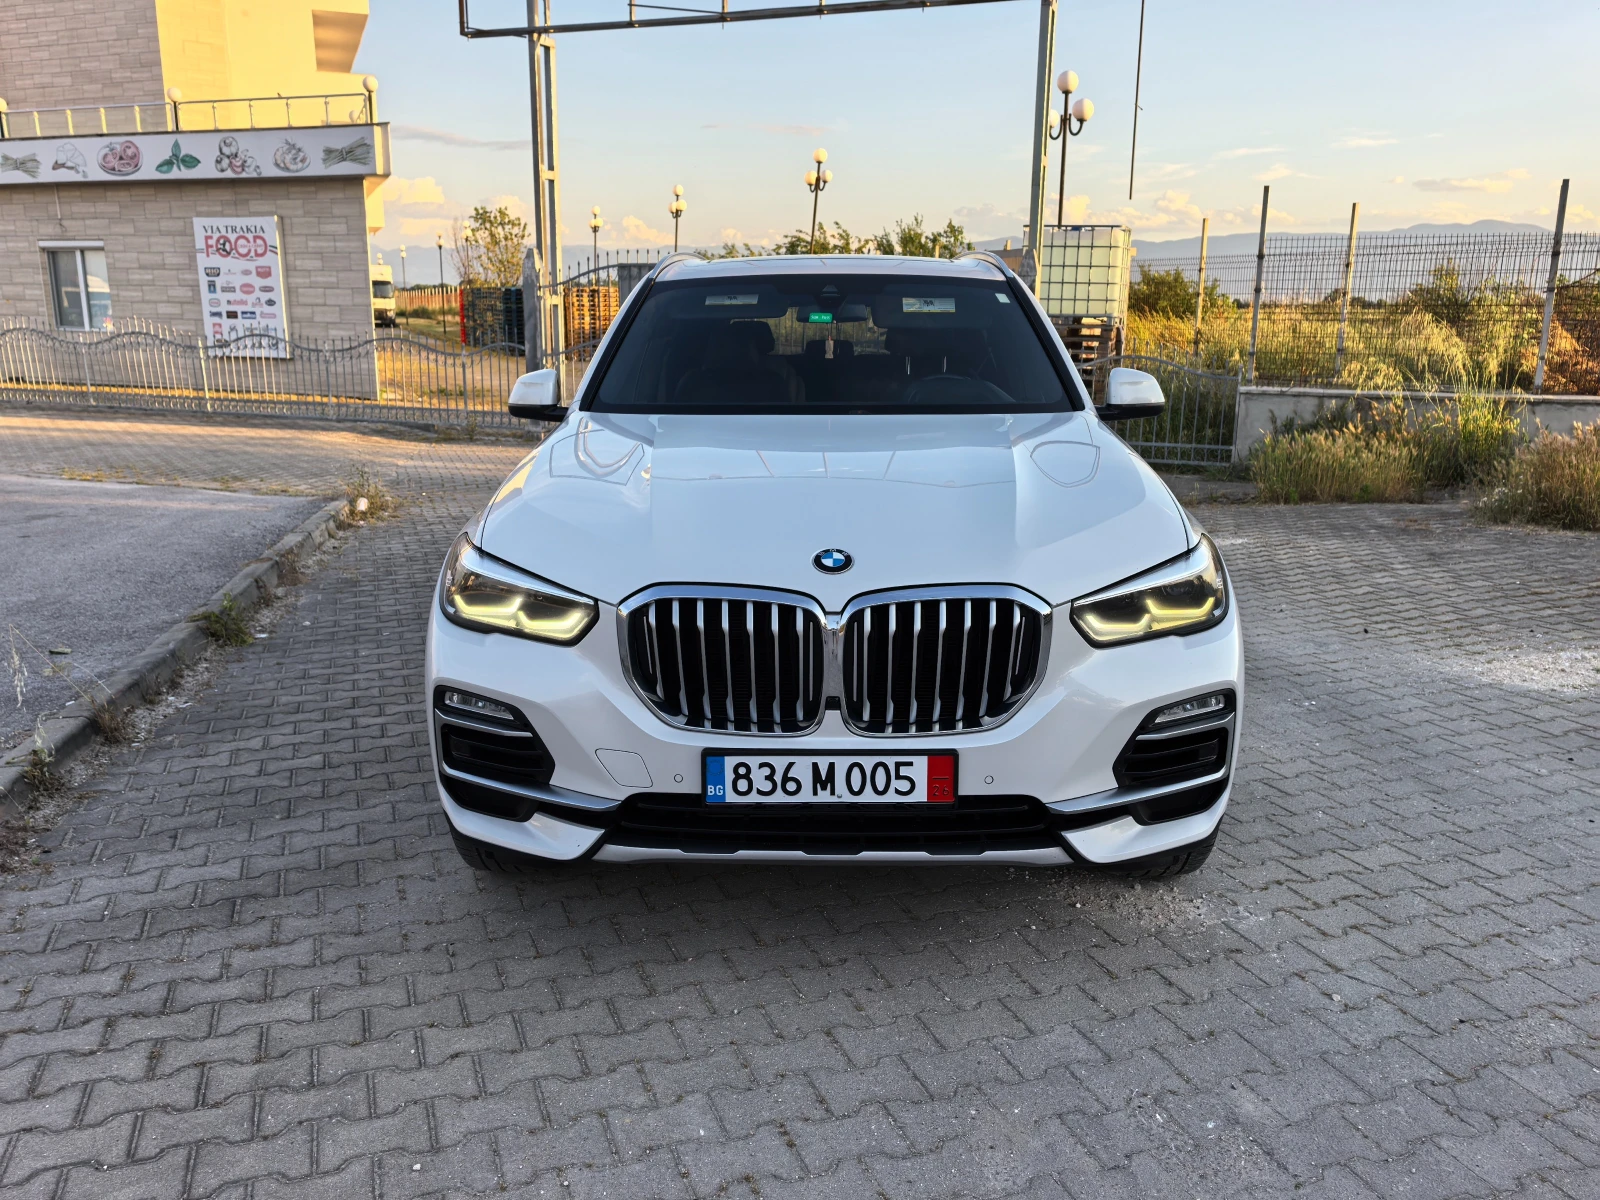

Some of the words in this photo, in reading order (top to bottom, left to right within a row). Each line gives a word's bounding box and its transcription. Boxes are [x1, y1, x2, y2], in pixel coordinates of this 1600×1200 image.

[203, 225, 221, 234] VIA
[223, 225, 265, 234] TRAKIA
[731, 761, 802, 797] 836
[811, 761, 836, 796] M
[845, 761, 916, 796] 005
[707, 785, 724, 795] BG
[932, 784, 950, 796] 26
